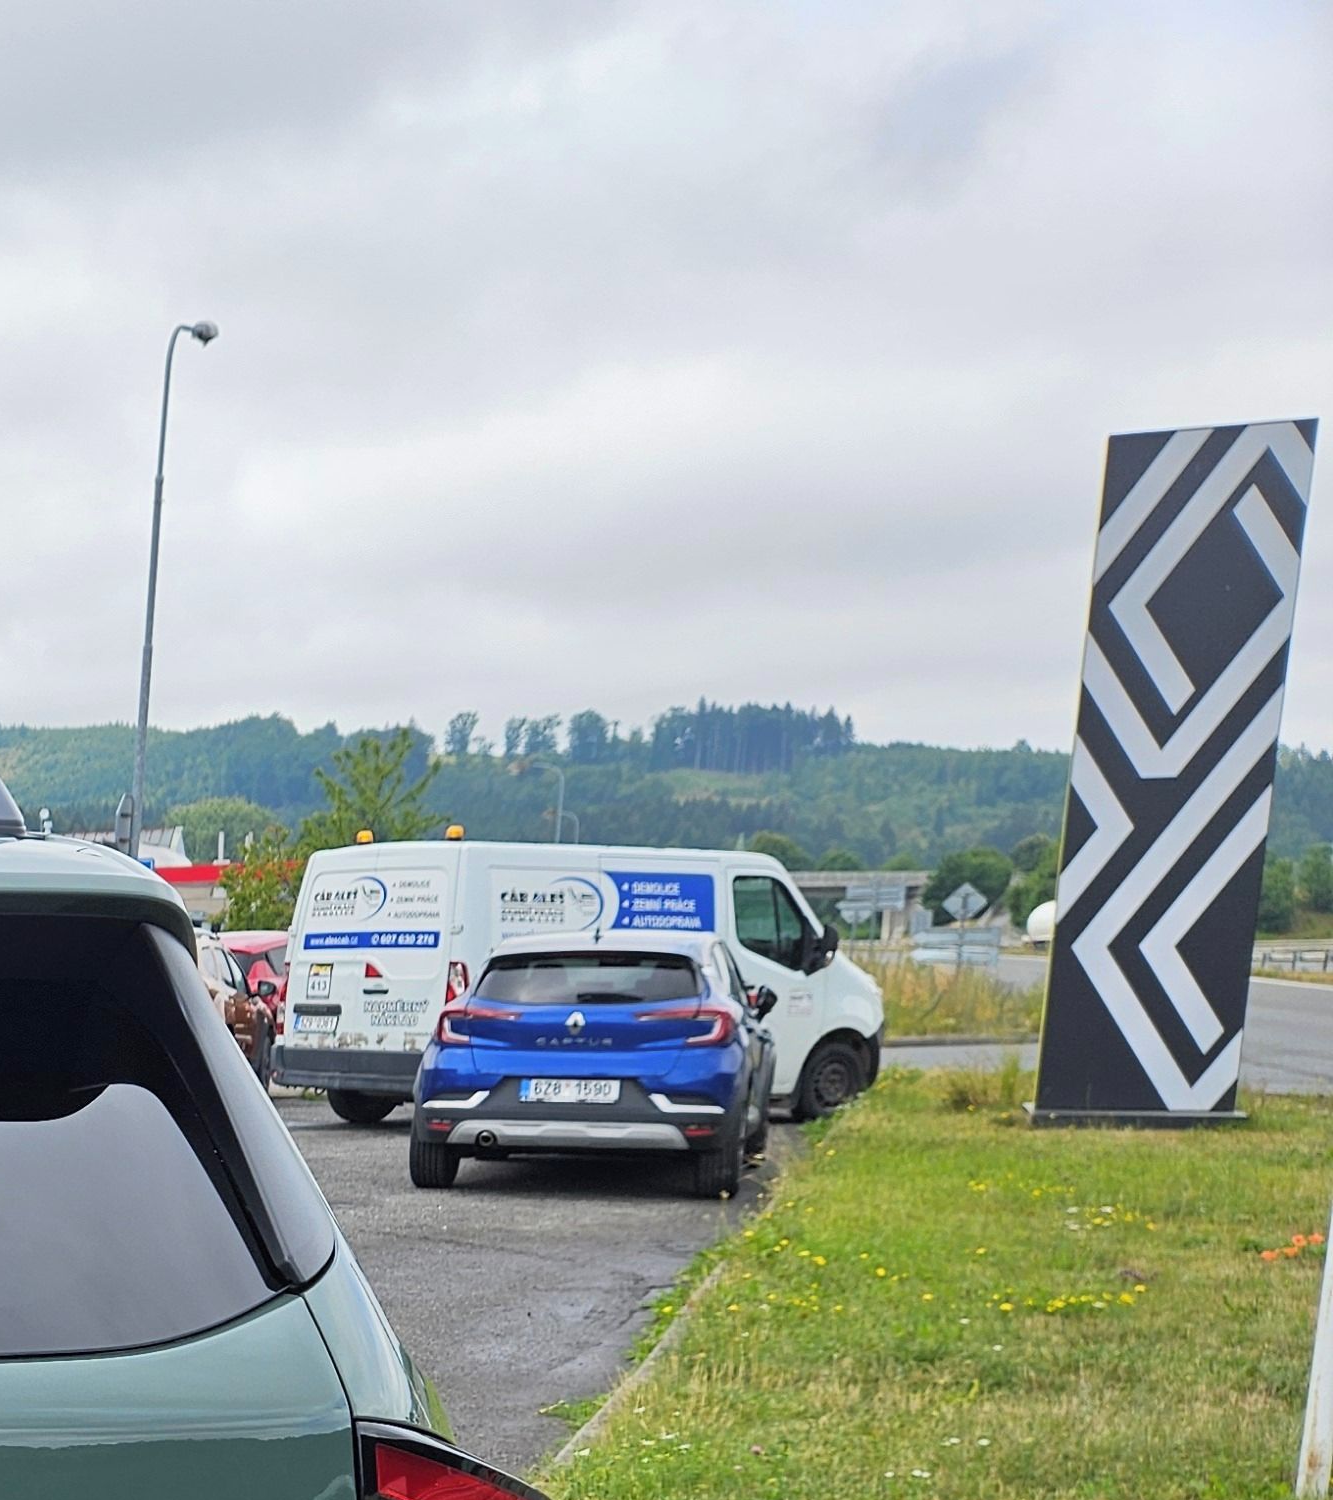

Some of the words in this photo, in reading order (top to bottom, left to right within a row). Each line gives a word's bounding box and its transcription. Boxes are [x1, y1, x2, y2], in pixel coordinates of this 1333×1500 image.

[631, 881, 681, 896] DEMOLICE
[630, 914, 702, 929] AUTODOPRAVA
[310, 979, 327, 991] 413
[536, 1037, 613, 1047] CAPTUR
